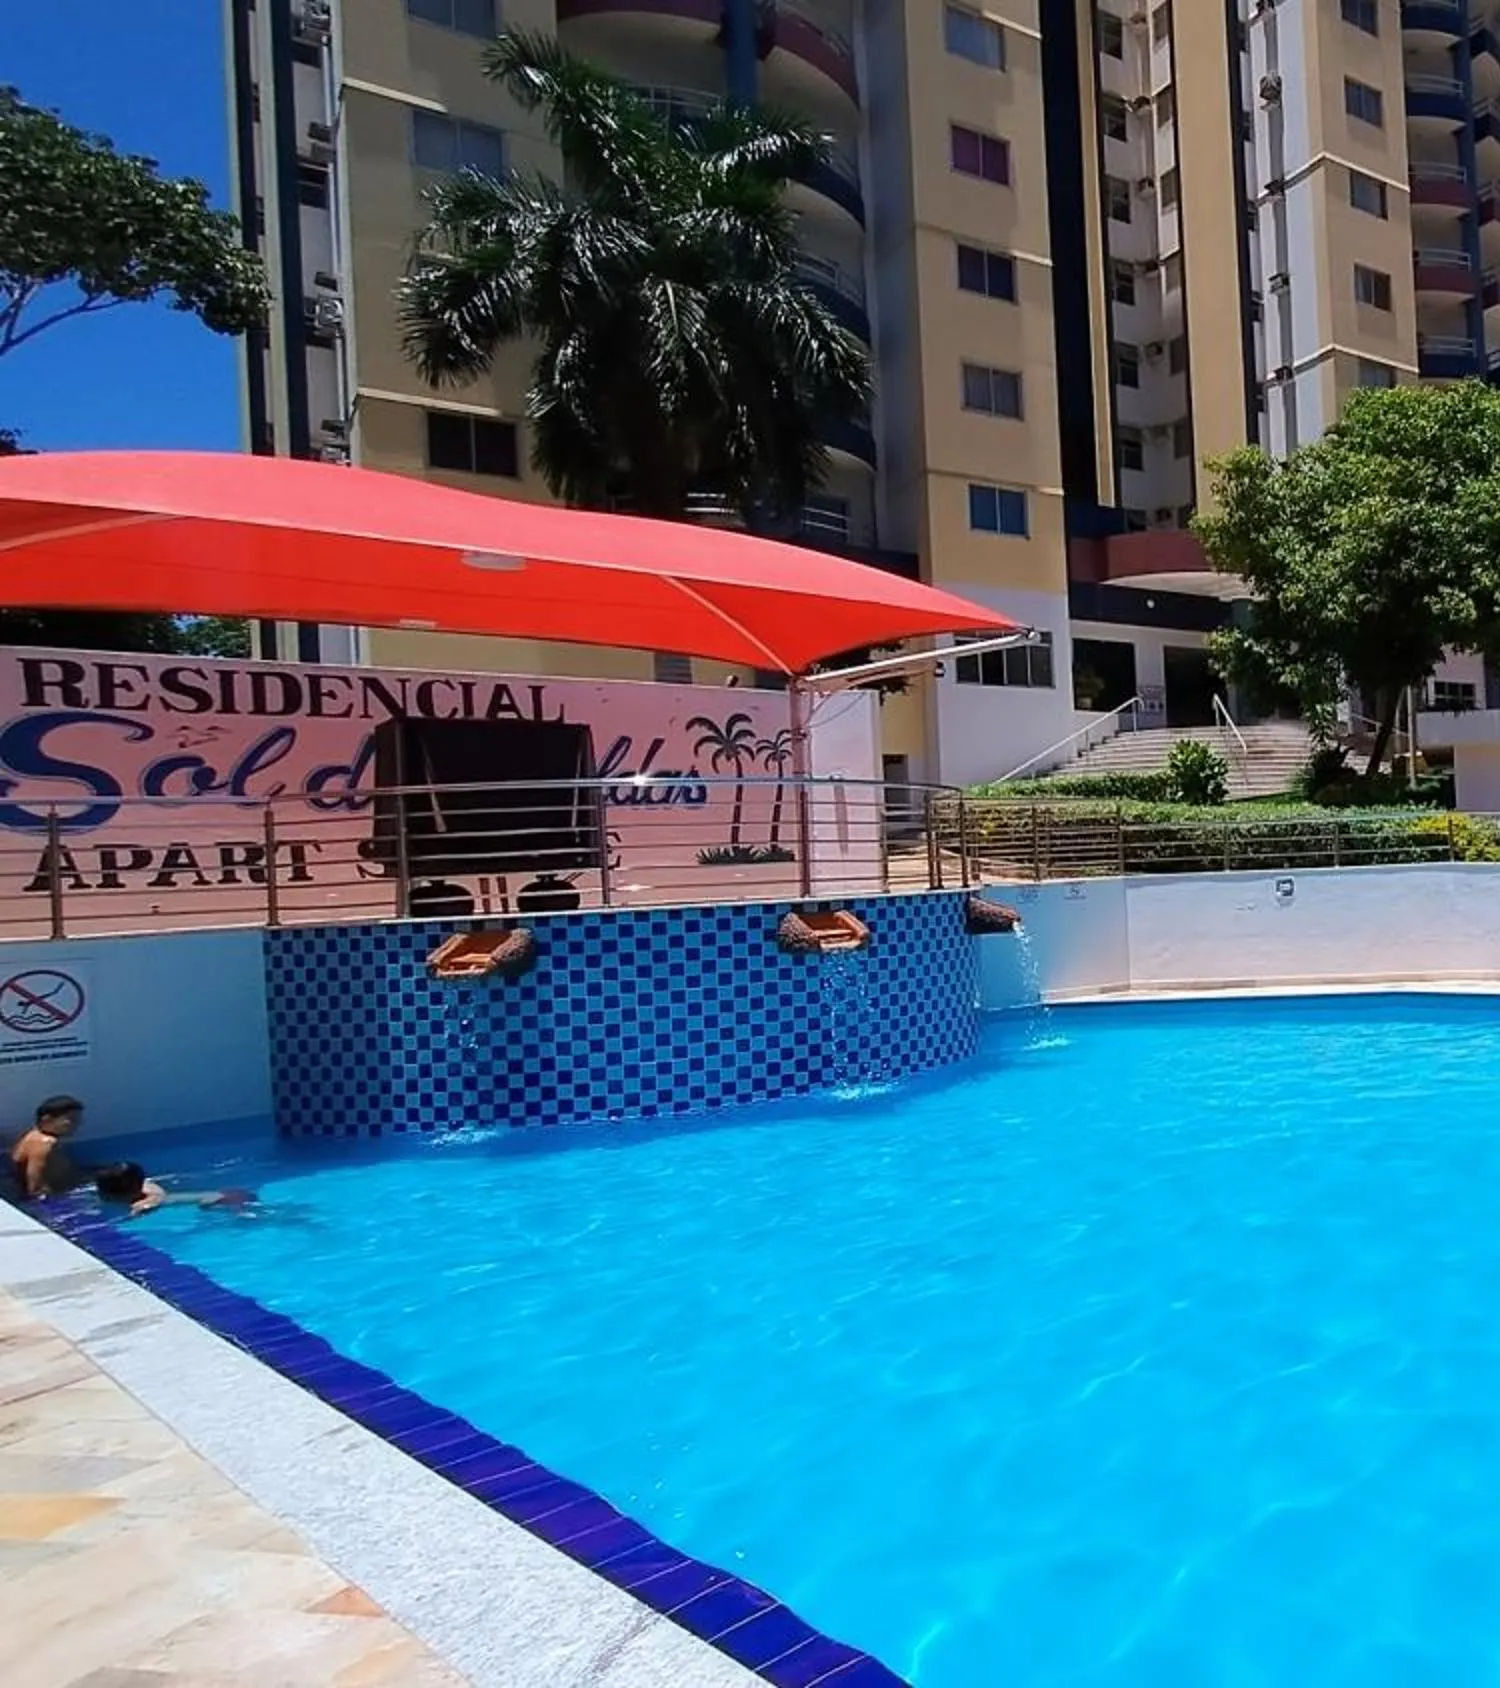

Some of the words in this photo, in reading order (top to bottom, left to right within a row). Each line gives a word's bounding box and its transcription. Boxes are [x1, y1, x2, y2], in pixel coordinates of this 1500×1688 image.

[16, 657, 565, 723] RESIDENCIAL
[0, 710, 297, 836] Sol
[23, 841, 322, 892] APART
